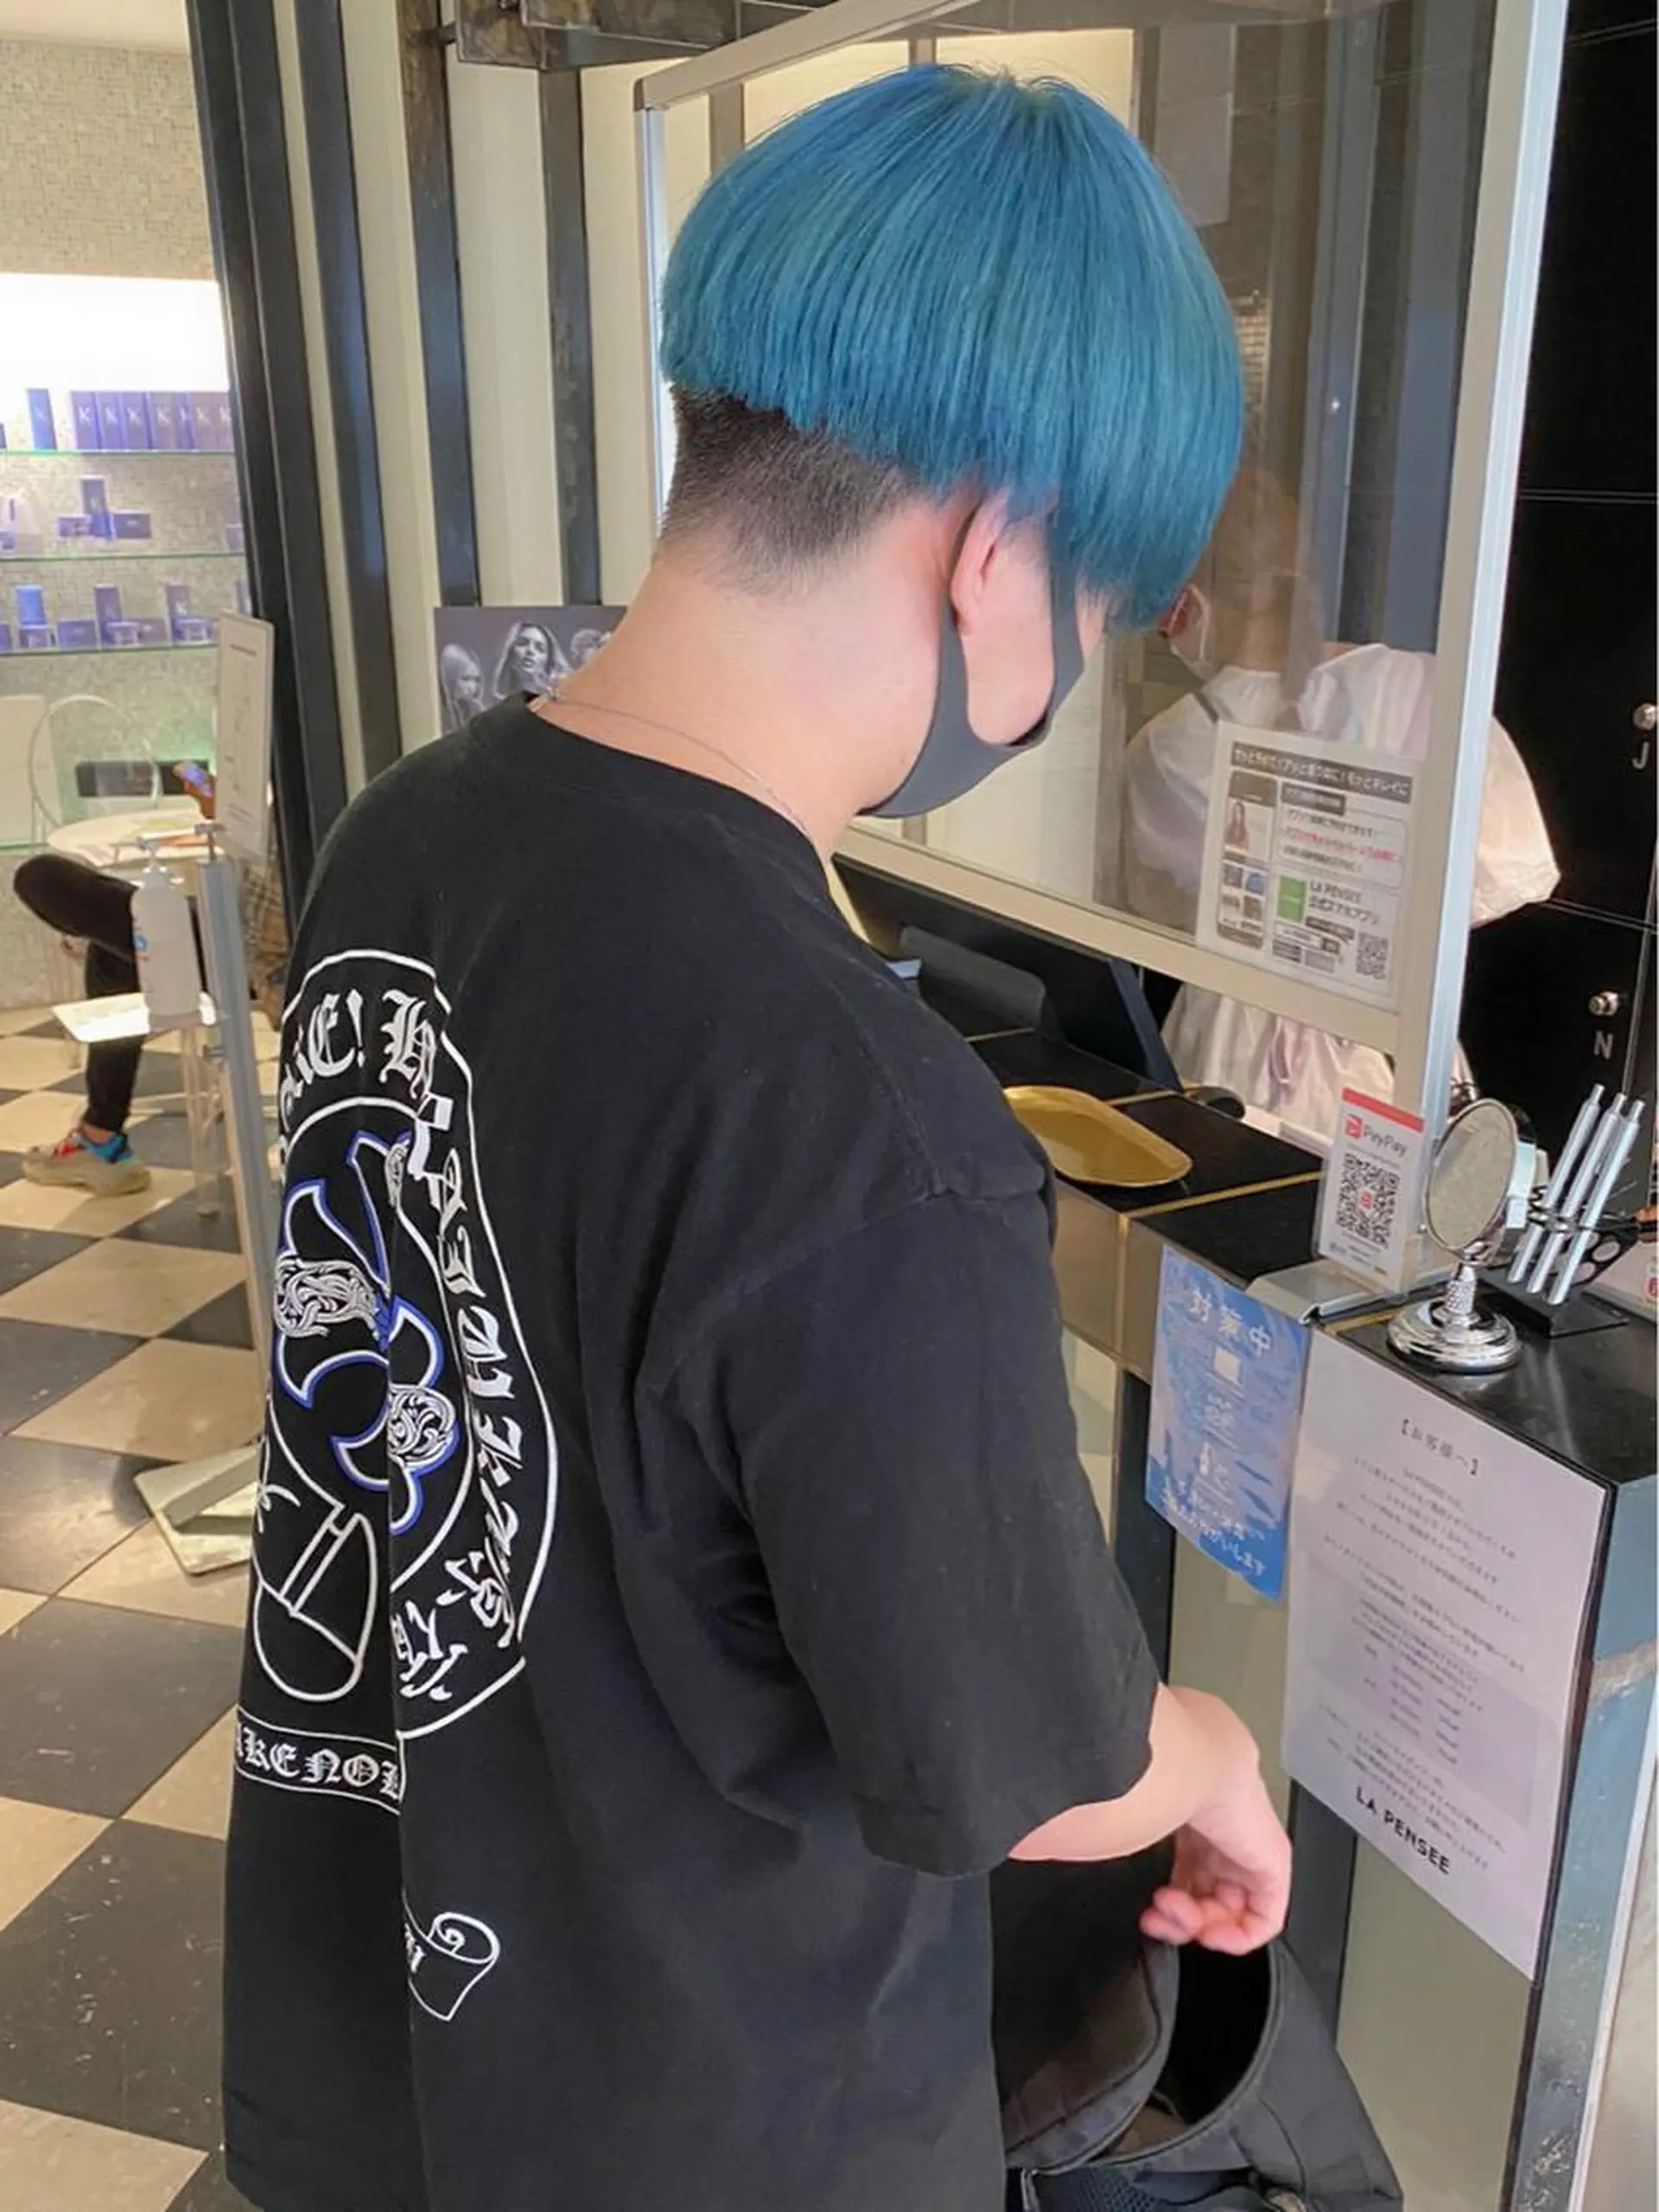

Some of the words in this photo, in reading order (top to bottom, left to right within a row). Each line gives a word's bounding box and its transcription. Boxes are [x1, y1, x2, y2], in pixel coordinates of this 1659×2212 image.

[1632, 741, 1649, 769] J
[1593, 1032, 1613, 1060] N
[1363, 1124, 1408, 1156] PayPay
[1356, 1785, 1378, 1815] LA
[1384, 1808, 1452, 1877] PENSEE
